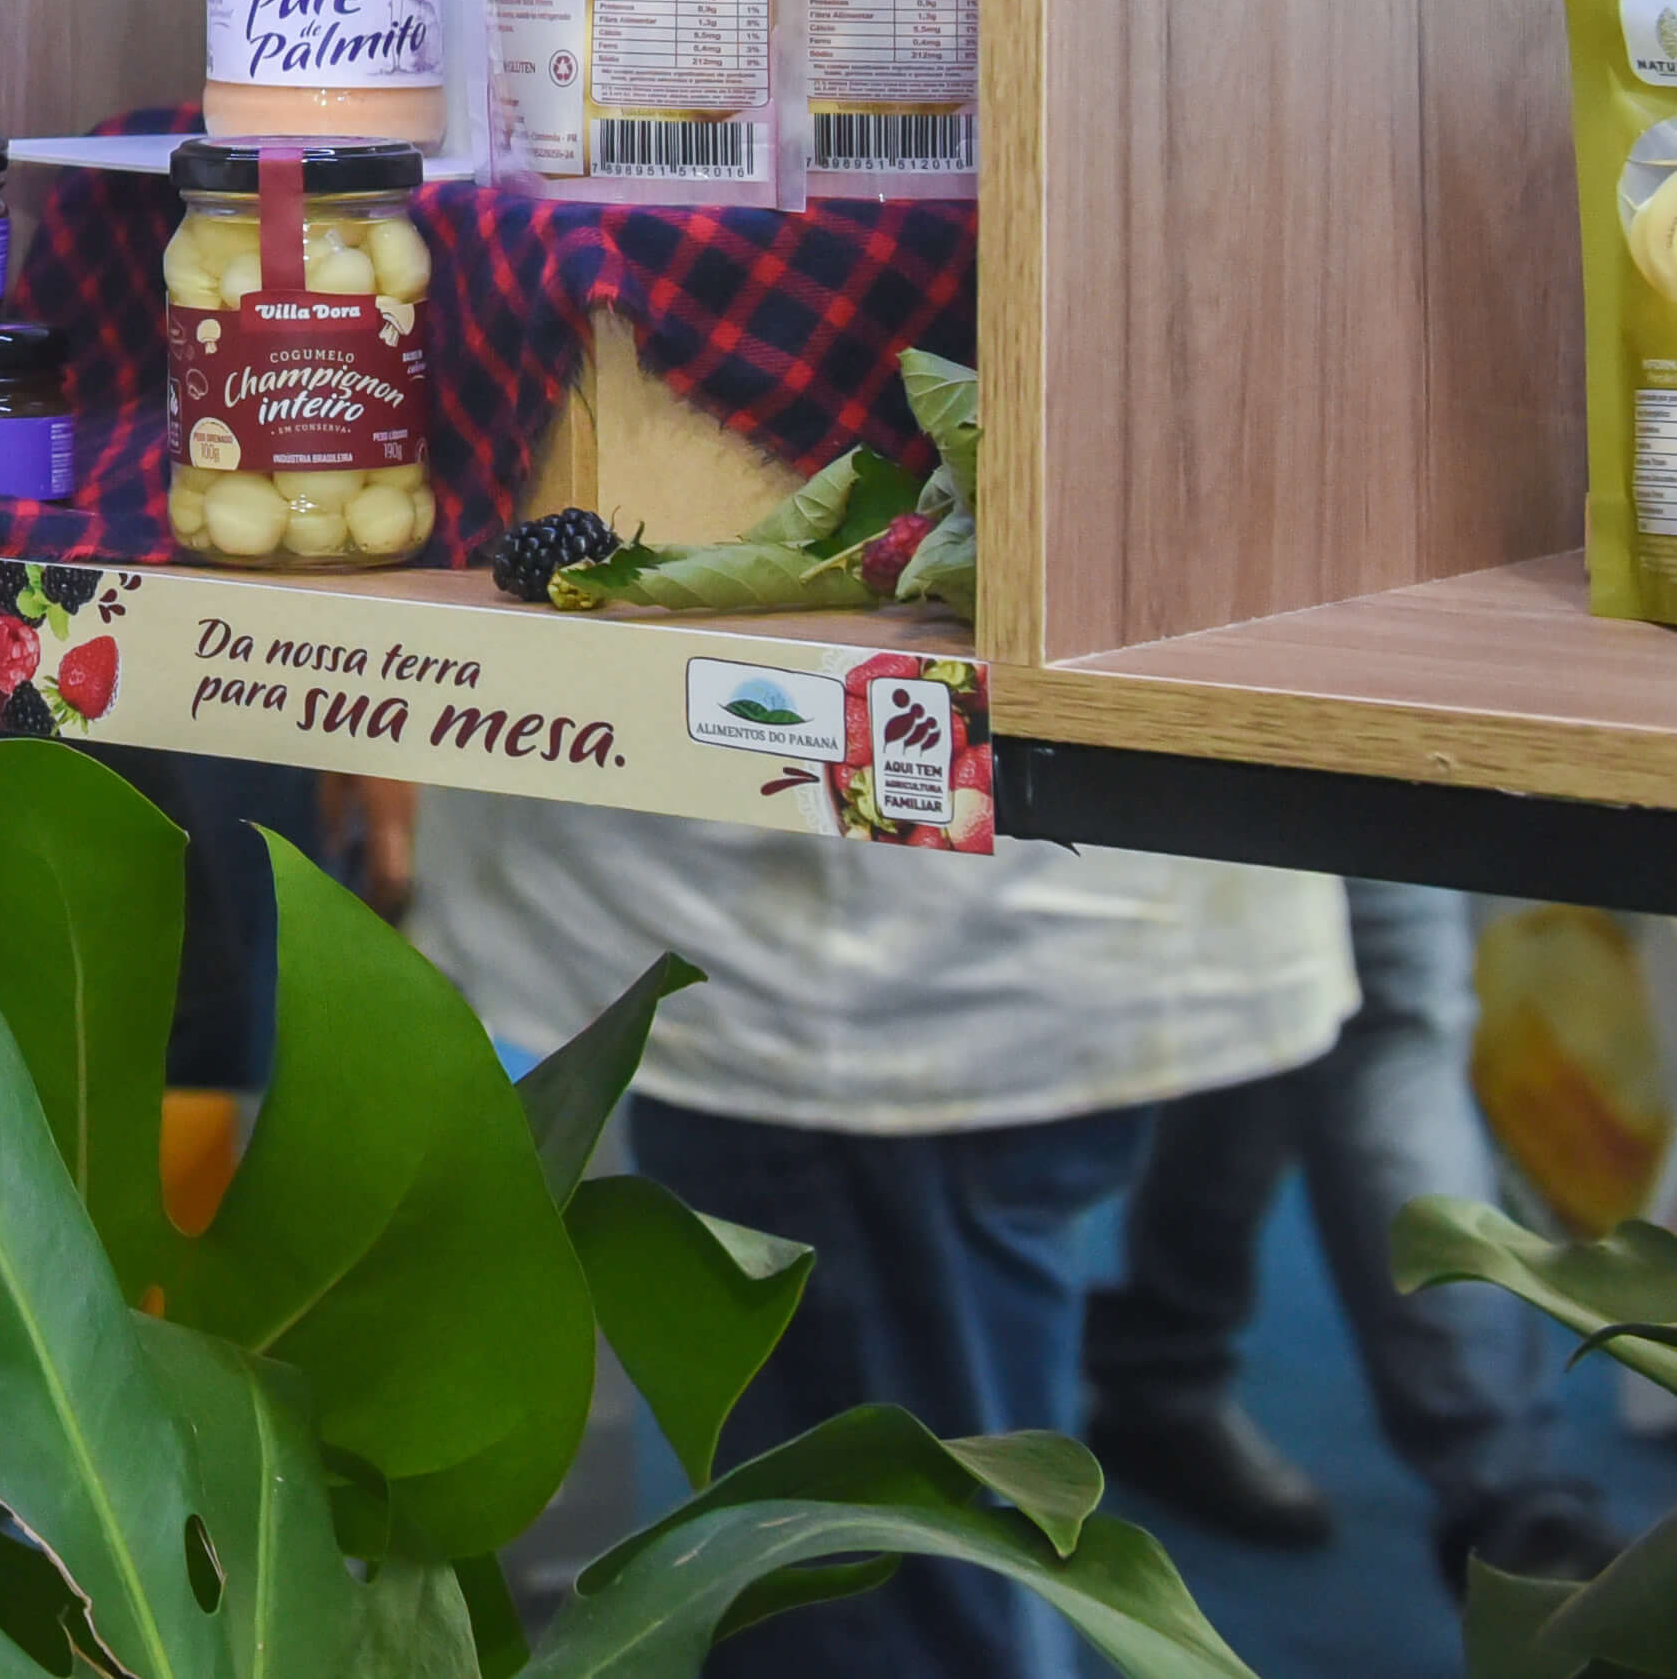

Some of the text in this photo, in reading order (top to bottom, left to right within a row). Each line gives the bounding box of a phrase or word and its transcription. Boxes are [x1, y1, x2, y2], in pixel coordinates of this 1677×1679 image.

[300, 19, 321, 39] de
[249, 14, 427, 78] Palmito
[256, 303, 361, 319] Villa Dora
[269, 349, 355, 363] COGUMELO
[224, 364, 405, 409] Champignon
[258, 389, 365, 425] inteiro
[295, 423, 346, 434] CONSERVA
[194, 617, 482, 690] Da nossa terra
[191, 674, 626, 770] para sua mesa.
[696, 722, 839, 751] ALIMENTOS DO PARANÁ
[884, 760, 943, 779] AQUI TEM
[884, 779, 943, 794] AGRICULTURA
[884, 795, 943, 813] FAMILIAR
